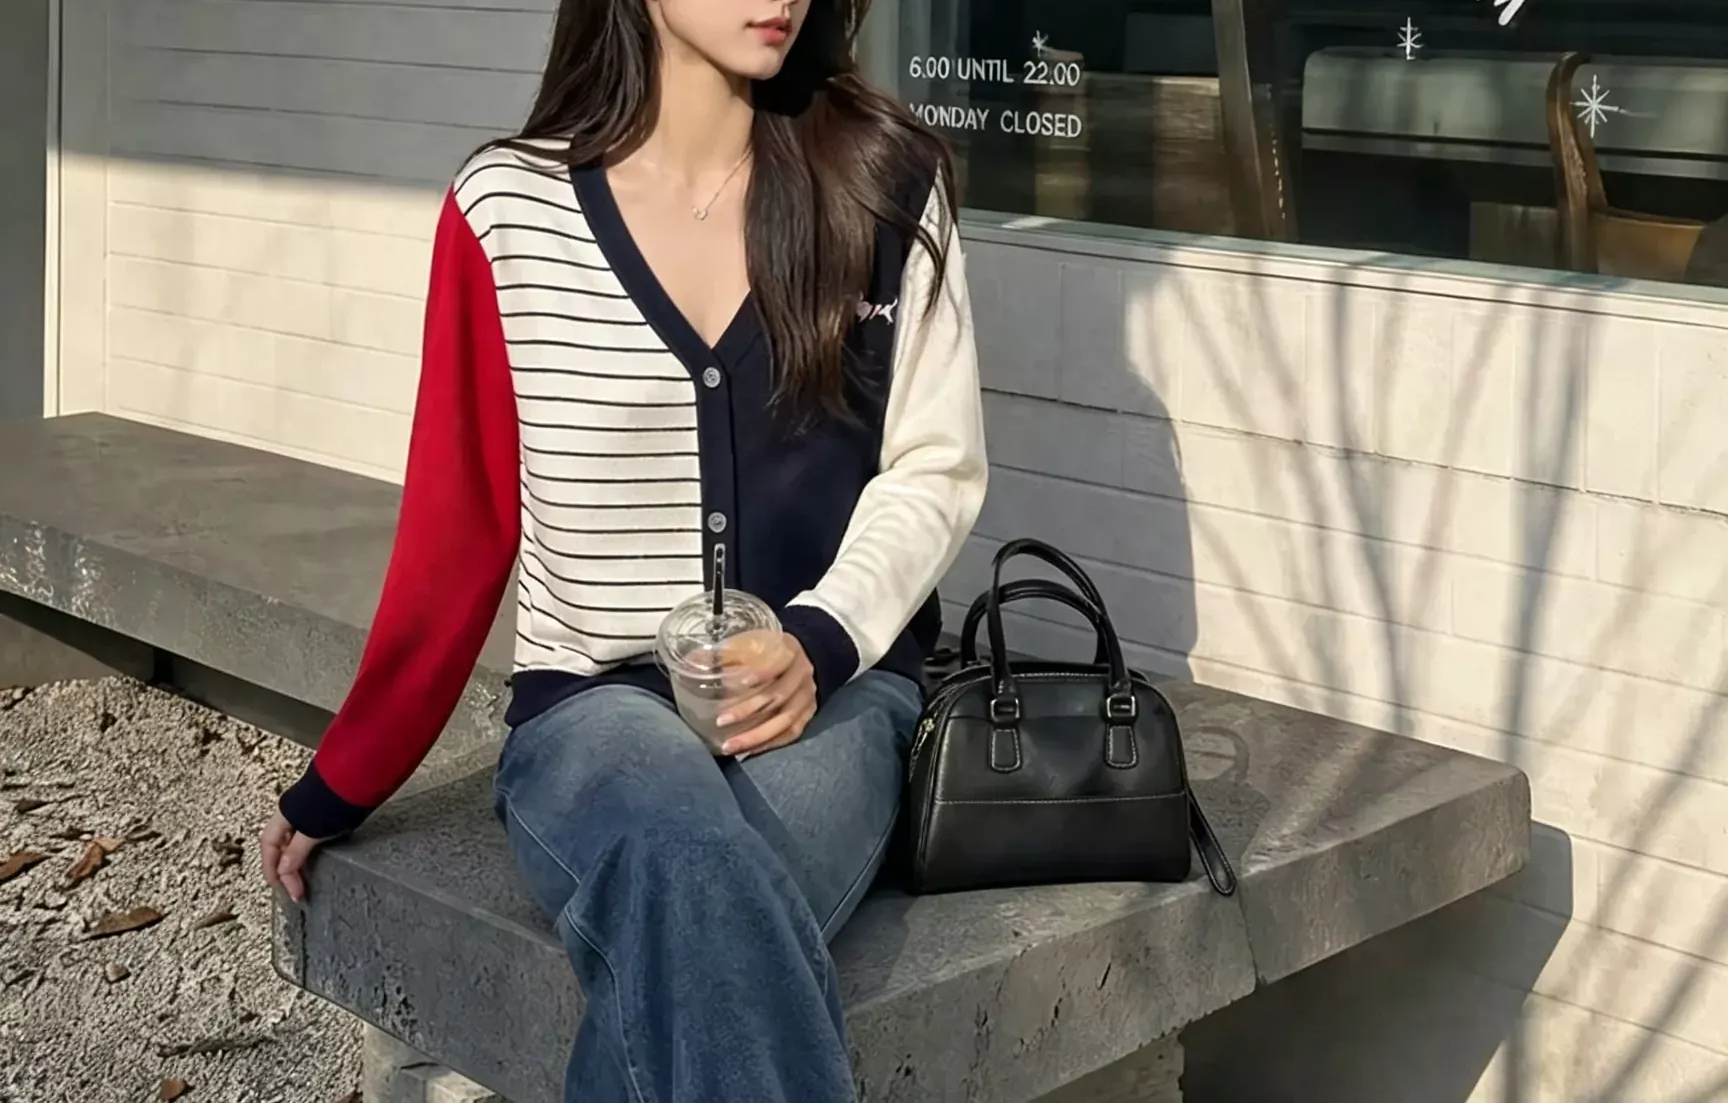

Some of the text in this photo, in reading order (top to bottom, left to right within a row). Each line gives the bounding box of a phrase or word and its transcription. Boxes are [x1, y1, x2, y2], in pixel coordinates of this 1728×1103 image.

[909, 56, 1081, 87] 6.00 UNTIL 22.00
[1000, 109, 1083, 138] CLOSED
